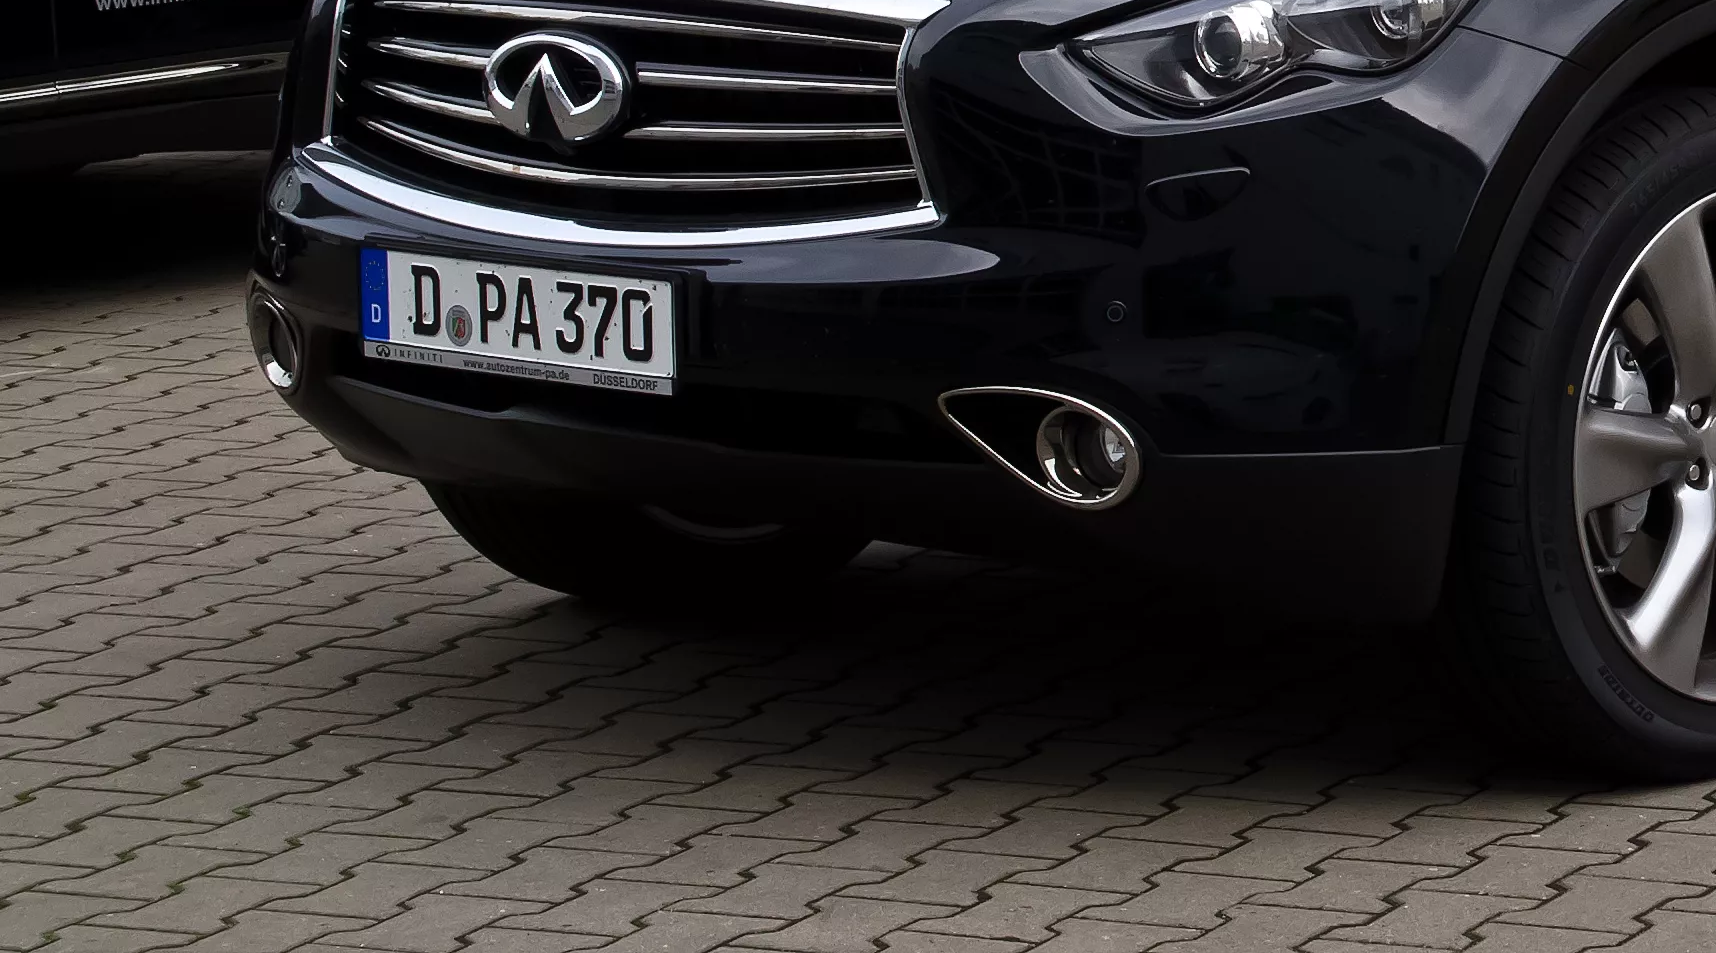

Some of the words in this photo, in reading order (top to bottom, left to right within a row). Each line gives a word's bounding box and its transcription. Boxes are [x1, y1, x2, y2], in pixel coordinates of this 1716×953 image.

[371, 303, 382, 324] D
[410, 262, 442, 337] D
[475, 270, 543, 352] PA
[554, 278, 654, 363] 370
[393, 348, 444, 364] INFINITI
[462, 358, 570, 381] www.autozentrum-pa.de
[592, 372, 659, 392] DÜSSELDORF
